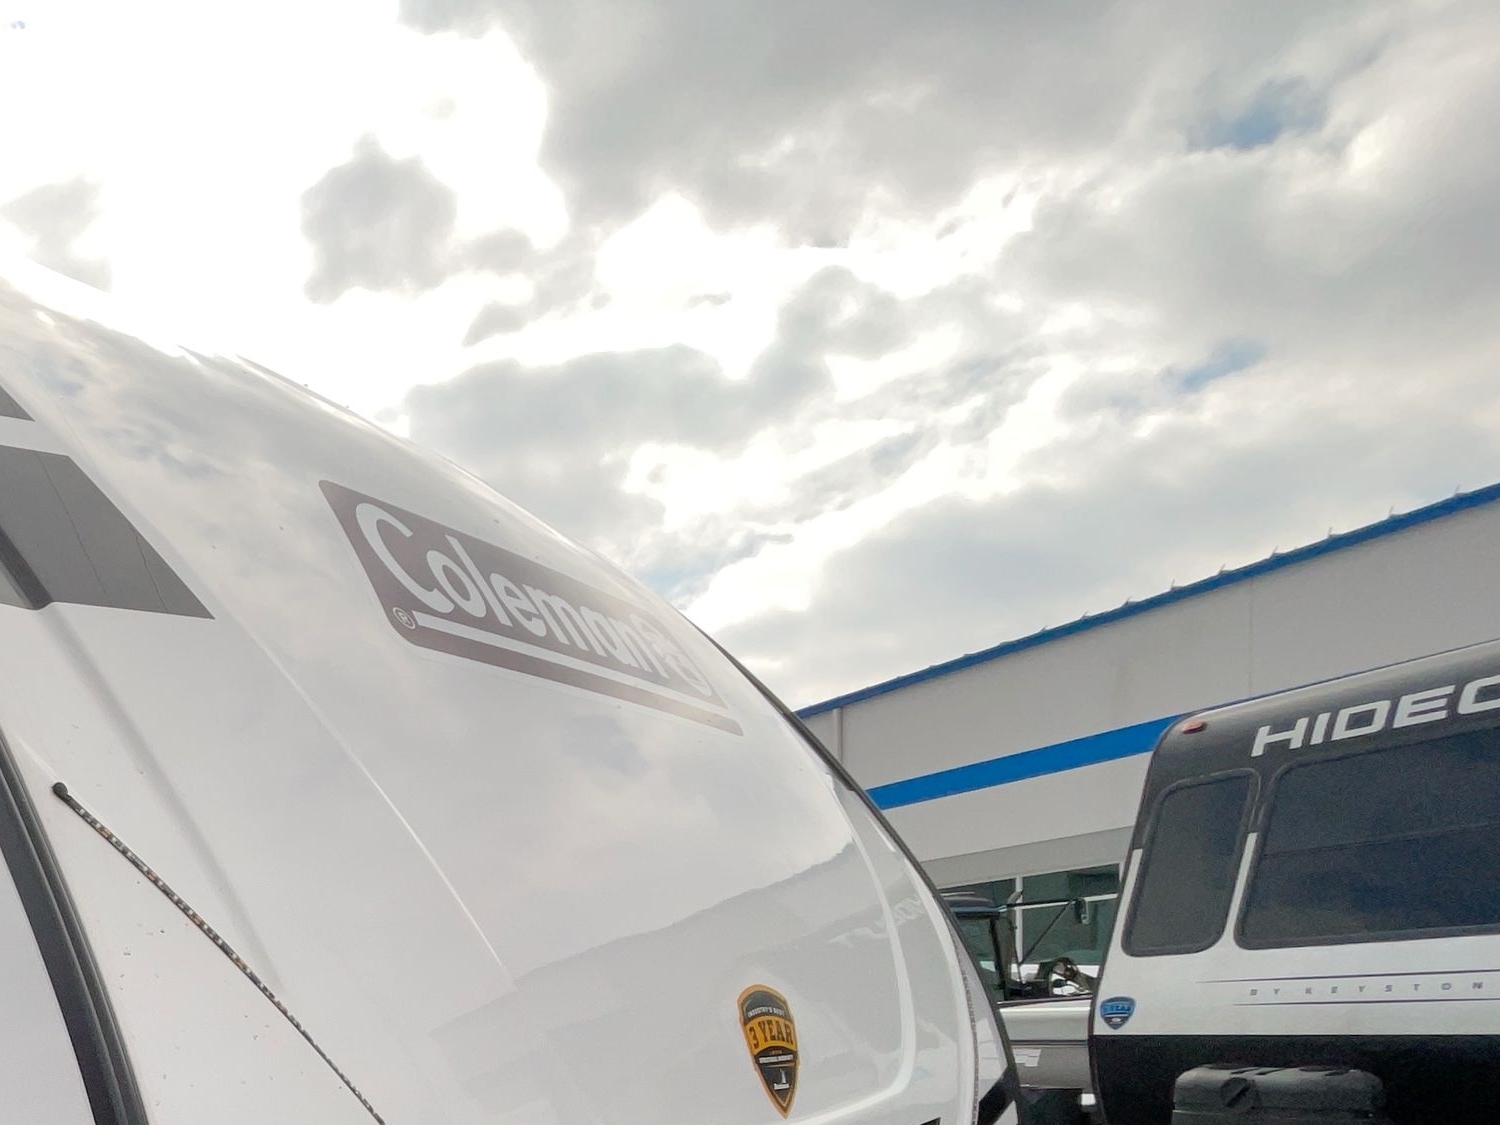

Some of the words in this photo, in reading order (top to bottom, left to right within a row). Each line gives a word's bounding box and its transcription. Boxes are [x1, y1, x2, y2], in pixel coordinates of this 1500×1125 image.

[355, 502, 670, 679] Coleman
[748, 1025, 760, 1050] 3
[758, 1019, 794, 1047] YEAR
